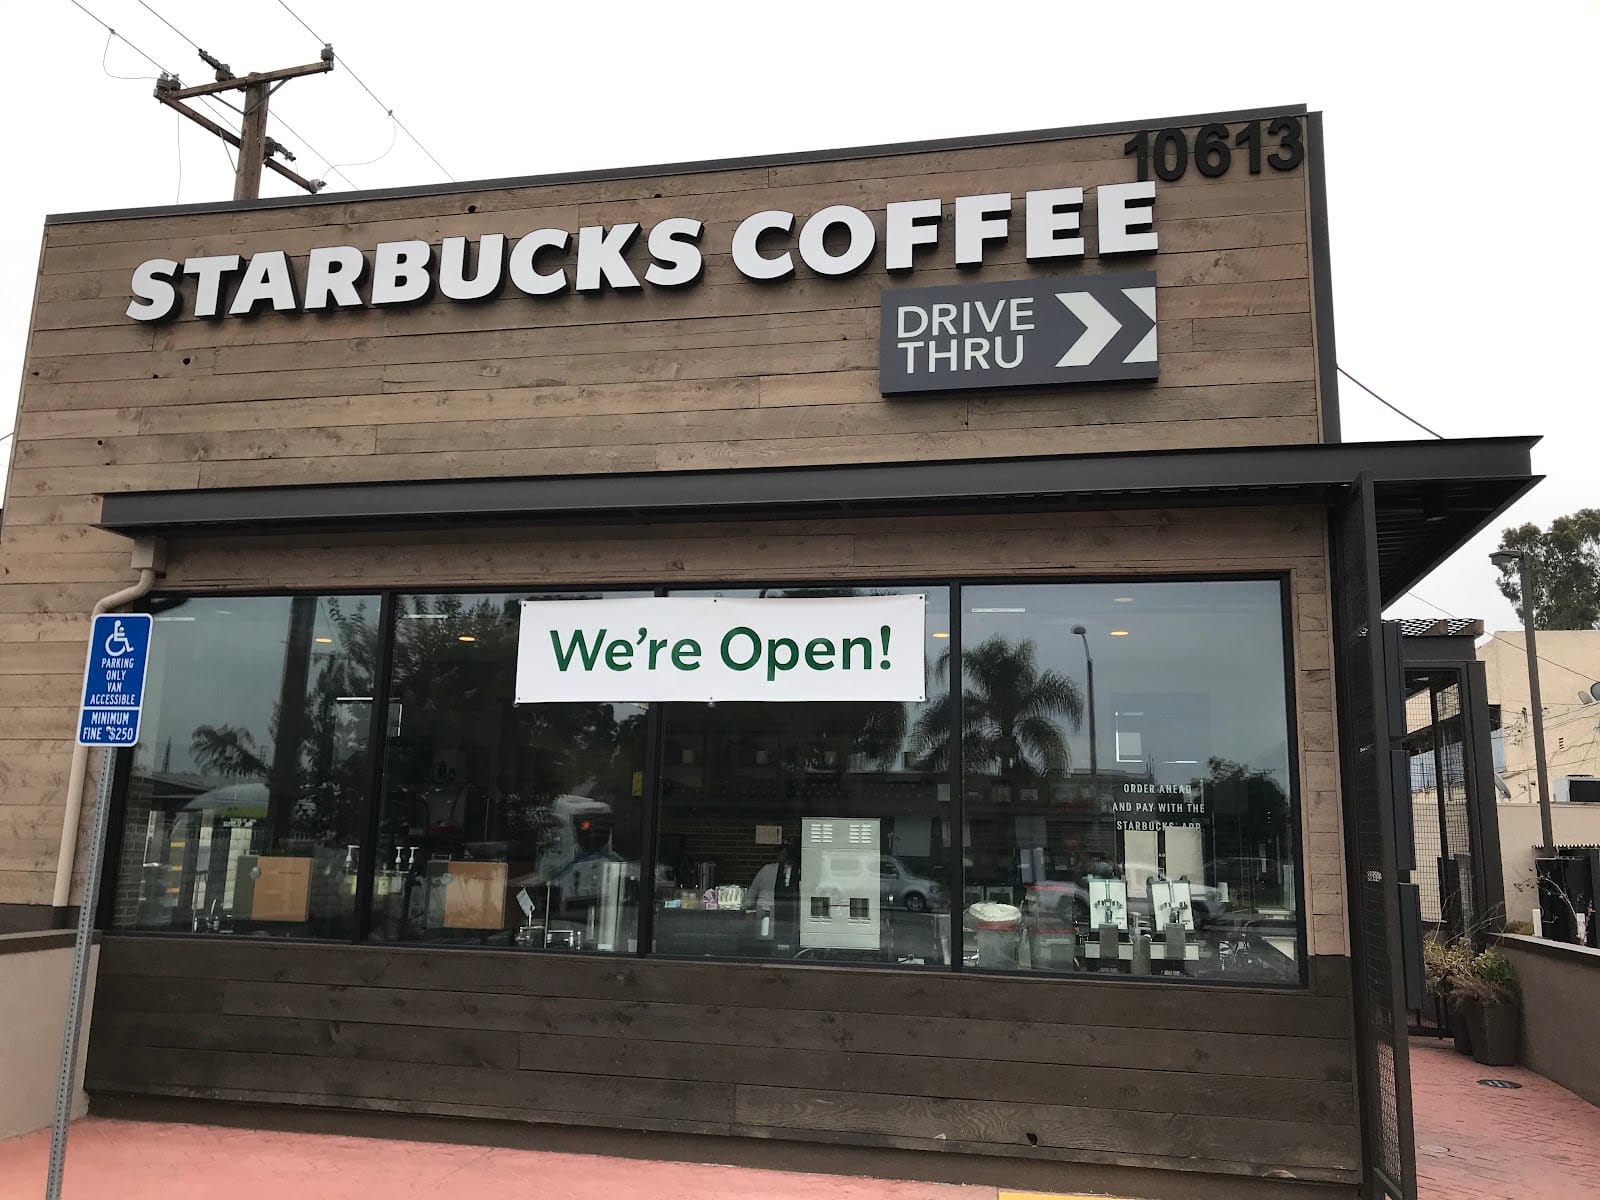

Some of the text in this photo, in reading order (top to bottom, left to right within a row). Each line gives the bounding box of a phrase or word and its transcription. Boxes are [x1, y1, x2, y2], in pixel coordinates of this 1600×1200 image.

[1124, 116, 1304, 183] 10613
[125, 181, 1159, 322] STARBUCKS COFFEE
[897, 297, 1035, 339] DRIVE
[898, 335, 1024, 375] THRU
[550, 625, 892, 681] We’re Open!
[101, 658, 134, 668] PARKING
[106, 670, 126, 680] ONLY
[107, 682, 122, 692] VAN
[90, 694, 135, 705] ACCESSIBLE
[91, 712, 129, 724] MINIMUM
[83, 727, 133, 741] FINE $250
[1123, 783, 1192, 794] ORDER AHEAD
[1112, 802, 1205, 814] AND PAY WITH THE
